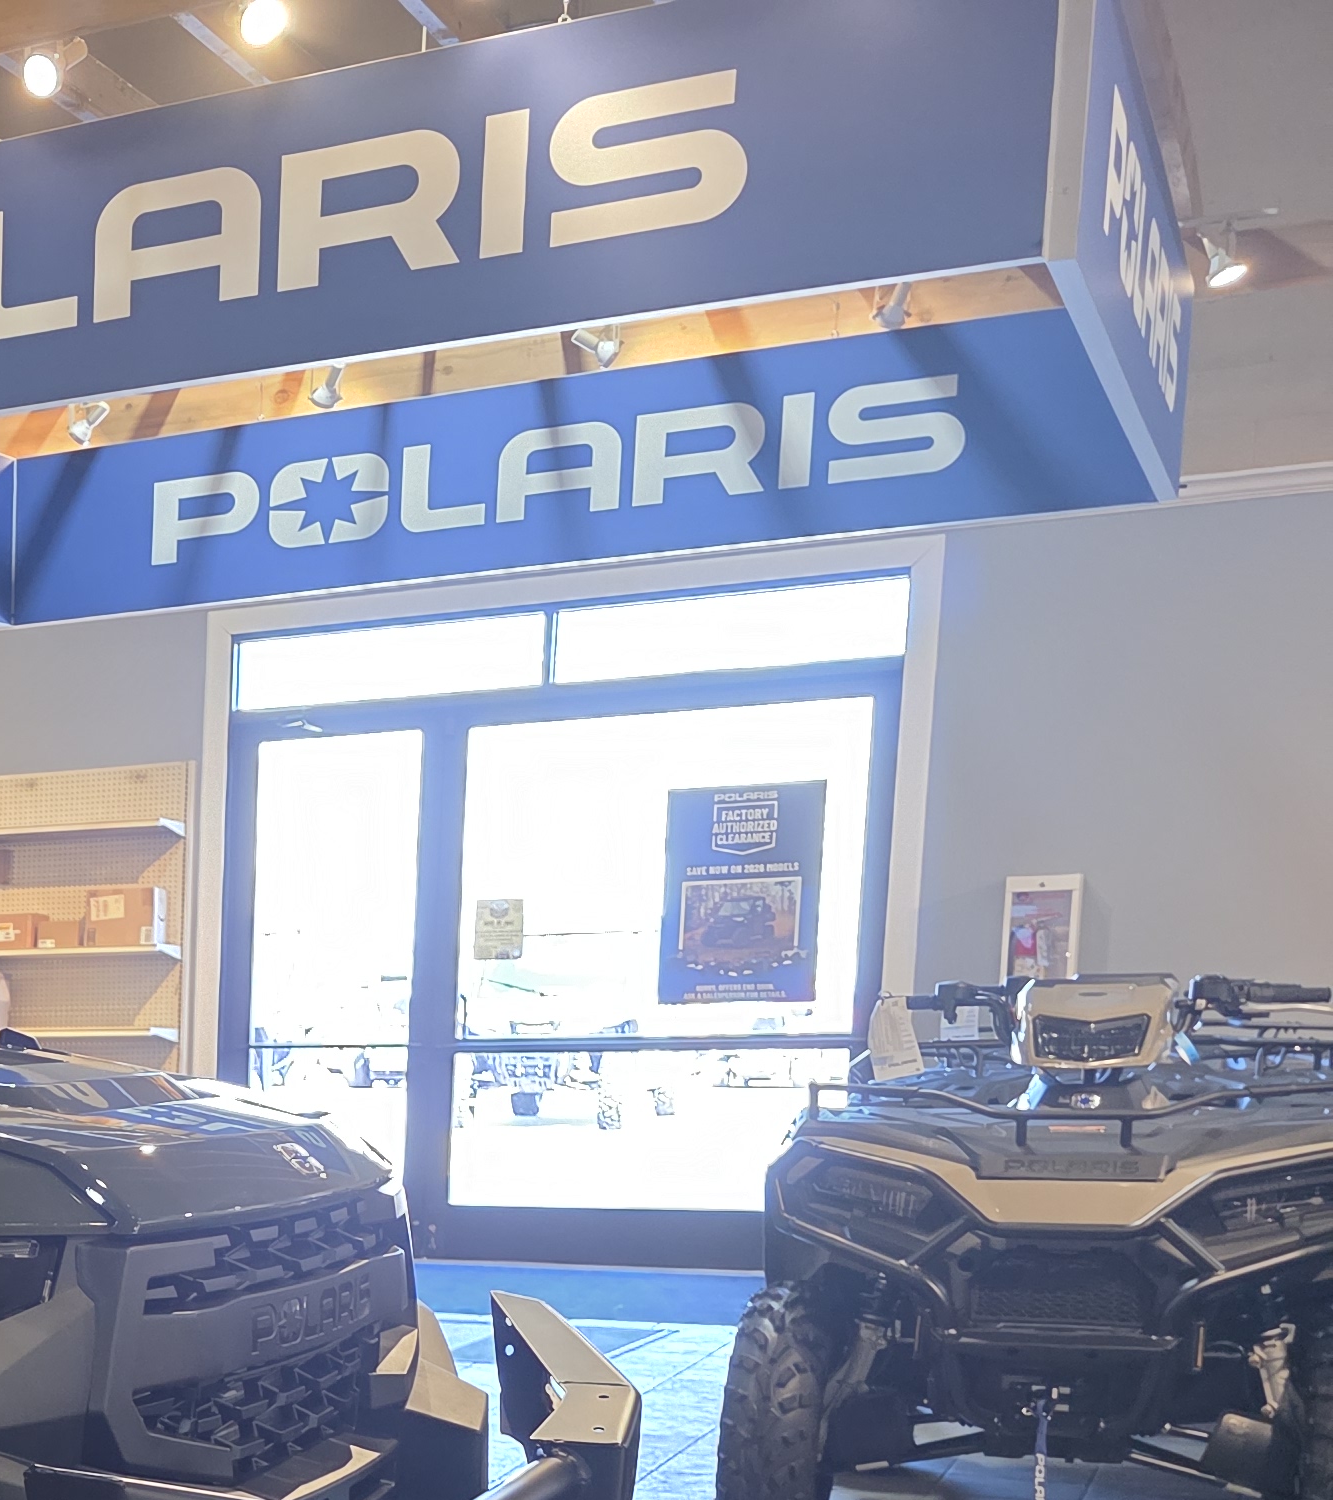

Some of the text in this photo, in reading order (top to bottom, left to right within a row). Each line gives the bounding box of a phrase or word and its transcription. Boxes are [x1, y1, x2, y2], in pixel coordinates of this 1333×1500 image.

[1103, 84, 1181, 413] POLARIS
[152, 374, 965, 565] POLARIS
[714, 790, 779, 802] POLARIS
[721, 808, 770, 822] FACTORY
[712, 820, 778, 834] AUTHORIZED
[716, 833, 772, 845] CLEARANCE
[686, 866, 708, 876] SAVE
[766, 862, 800, 873] MODELS
[1004, 1159, 1140, 1175] POLARIS
[251, 1273, 371, 1356] POLARIS
